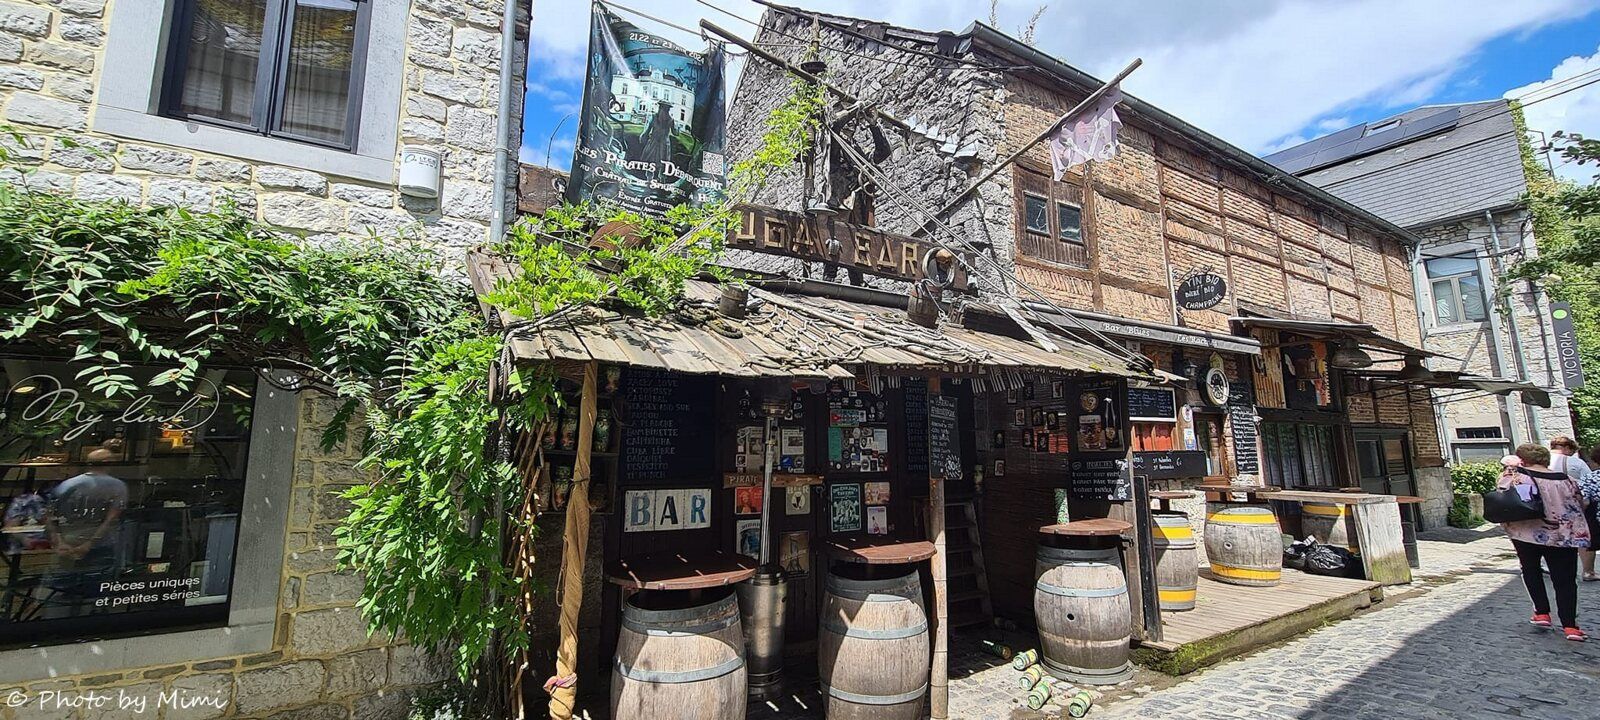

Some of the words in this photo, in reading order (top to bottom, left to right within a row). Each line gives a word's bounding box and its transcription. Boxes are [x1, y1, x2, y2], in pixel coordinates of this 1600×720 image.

[602, 148, 657, 172] PIRATES
[1559, 331, 1579, 379] VICTORIA
[630, 494, 707, 526] BAR
[99, 580, 146, 593] Pièces
[149, 577, 201, 589] uniques
[95, 596, 110, 607] et
[112, 593, 159, 607] petites
[162, 590, 201, 601] séries
